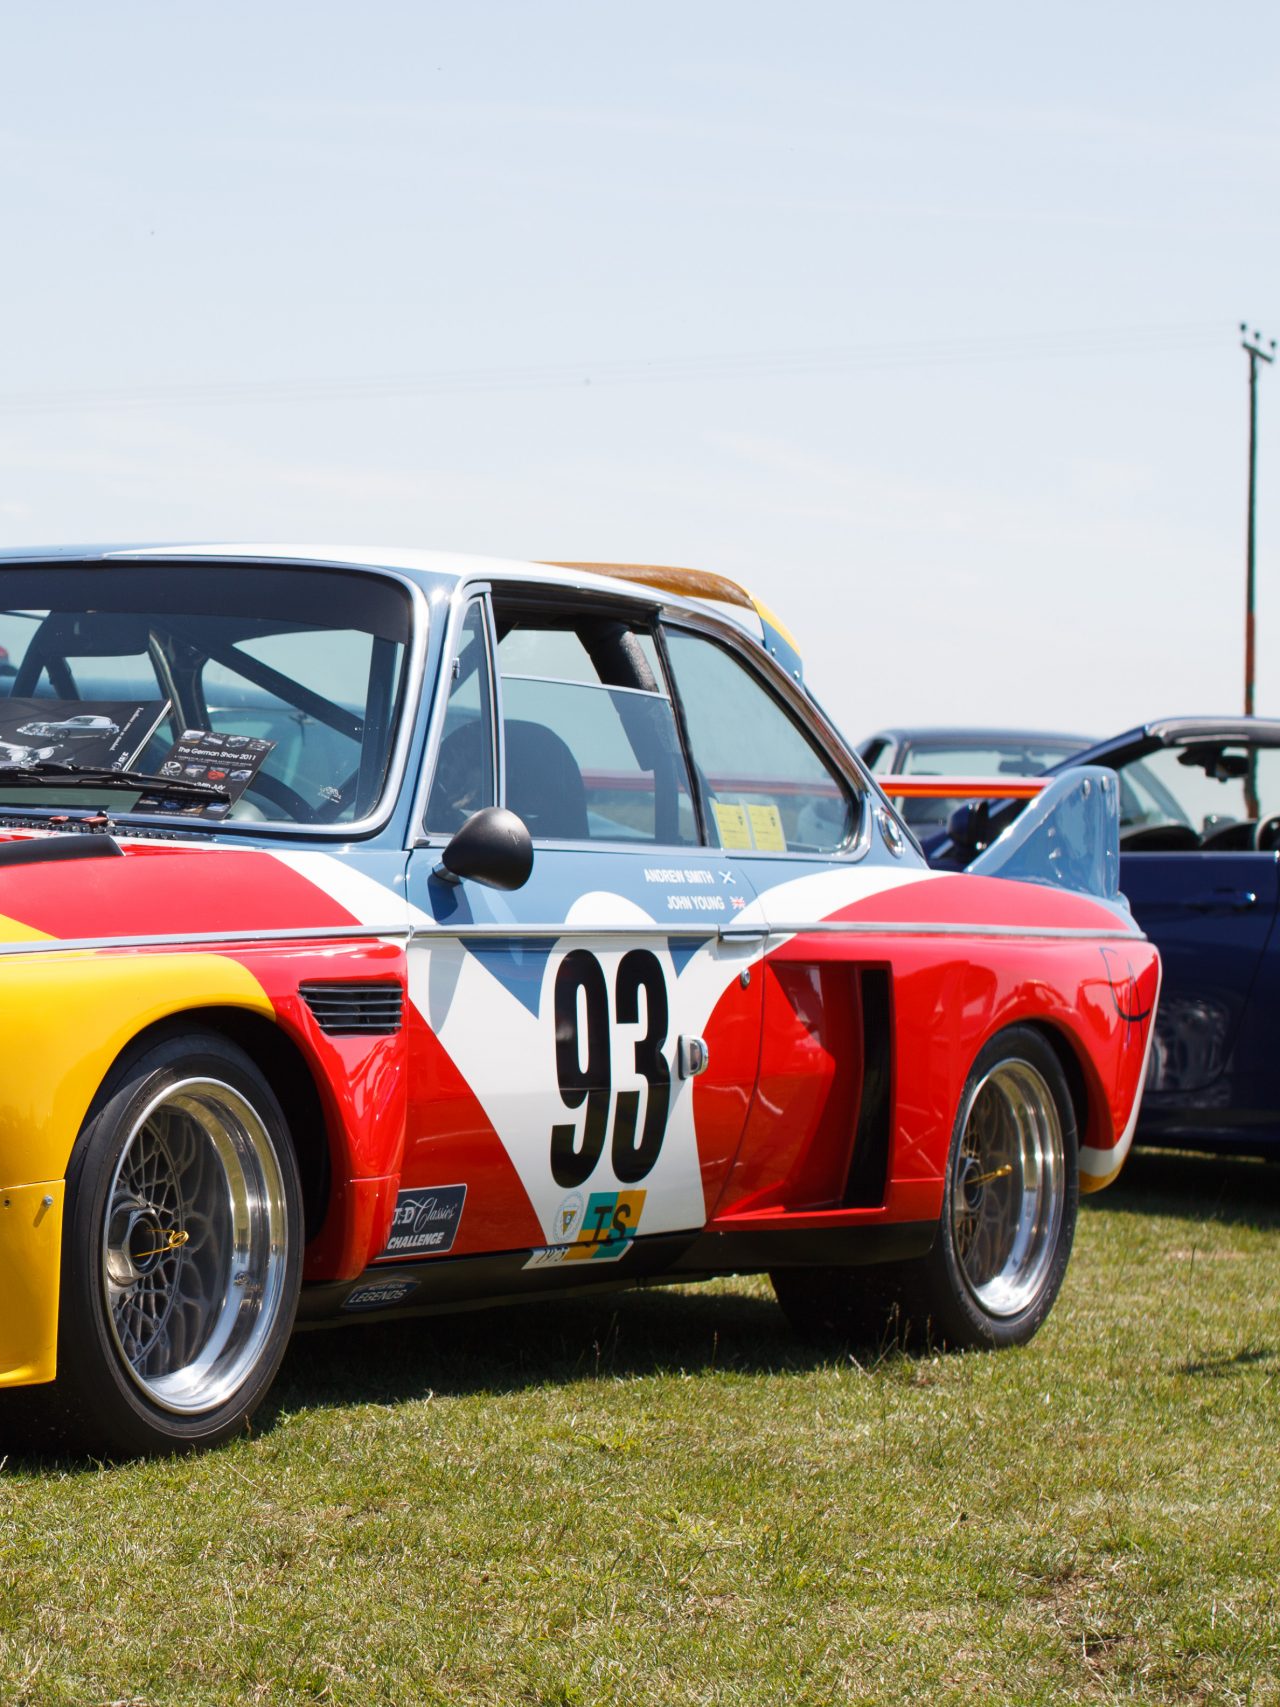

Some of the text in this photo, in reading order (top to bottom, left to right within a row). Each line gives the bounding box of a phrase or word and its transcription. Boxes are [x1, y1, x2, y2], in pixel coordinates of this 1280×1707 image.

[178, 746, 190, 754] The
[191, 748, 221, 757] German
[220, 751, 239, 760] Show
[239, 752, 257, 761] 2011
[643, 868, 715, 885] ANDREW SMITH
[666, 895, 726, 911] JOHN YOUNG
[549, 948, 671, 1189] 93
[387, 1231, 445, 1249] CHALLENGE
[348, 1289, 408, 1304] LEGENDS
